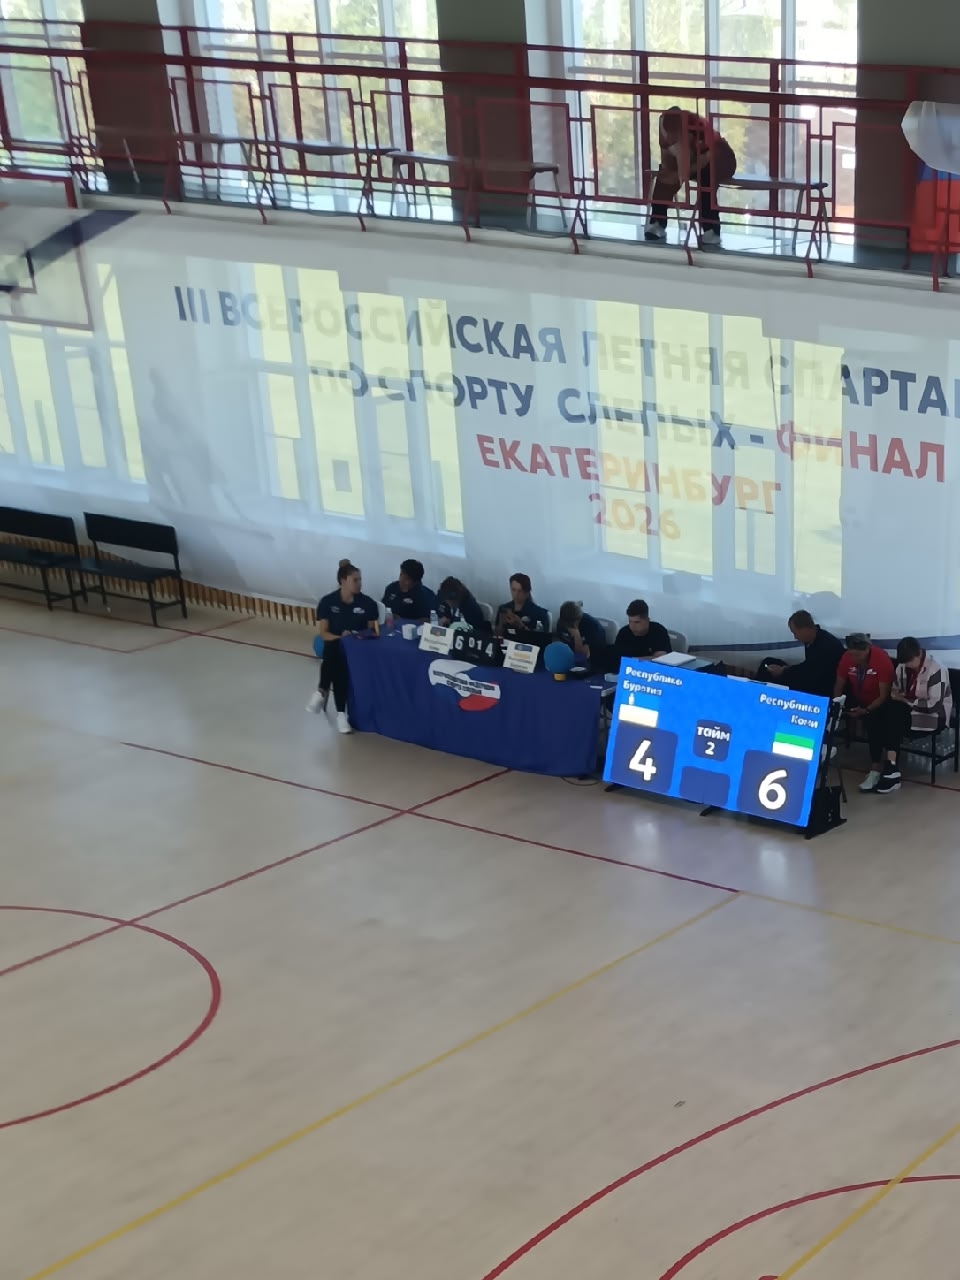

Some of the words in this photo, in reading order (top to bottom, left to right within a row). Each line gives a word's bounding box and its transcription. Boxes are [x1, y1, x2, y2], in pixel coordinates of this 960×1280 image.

[217, 290, 568, 364] ВСЕРОССИЙСКАЯ
[581, 330, 751, 390] ЛЕТНЯЯ
[375, 364, 535, 417] СПОРТУ
[557, 386, 738, 450] СЛЕПЫХ
[776, 419, 946, 484] ФИНАЛ
[476, 433, 782, 515] ЕКАТЕРИНБУРГ
[588, 492, 682, 541] 2026
[625, 665, 683, 686] Республика
[760, 693, 820, 714] Республика
[628, 739, 658, 781] 4
[704, 742, 715, 756] 2
[758, 769, 788, 810] 6
